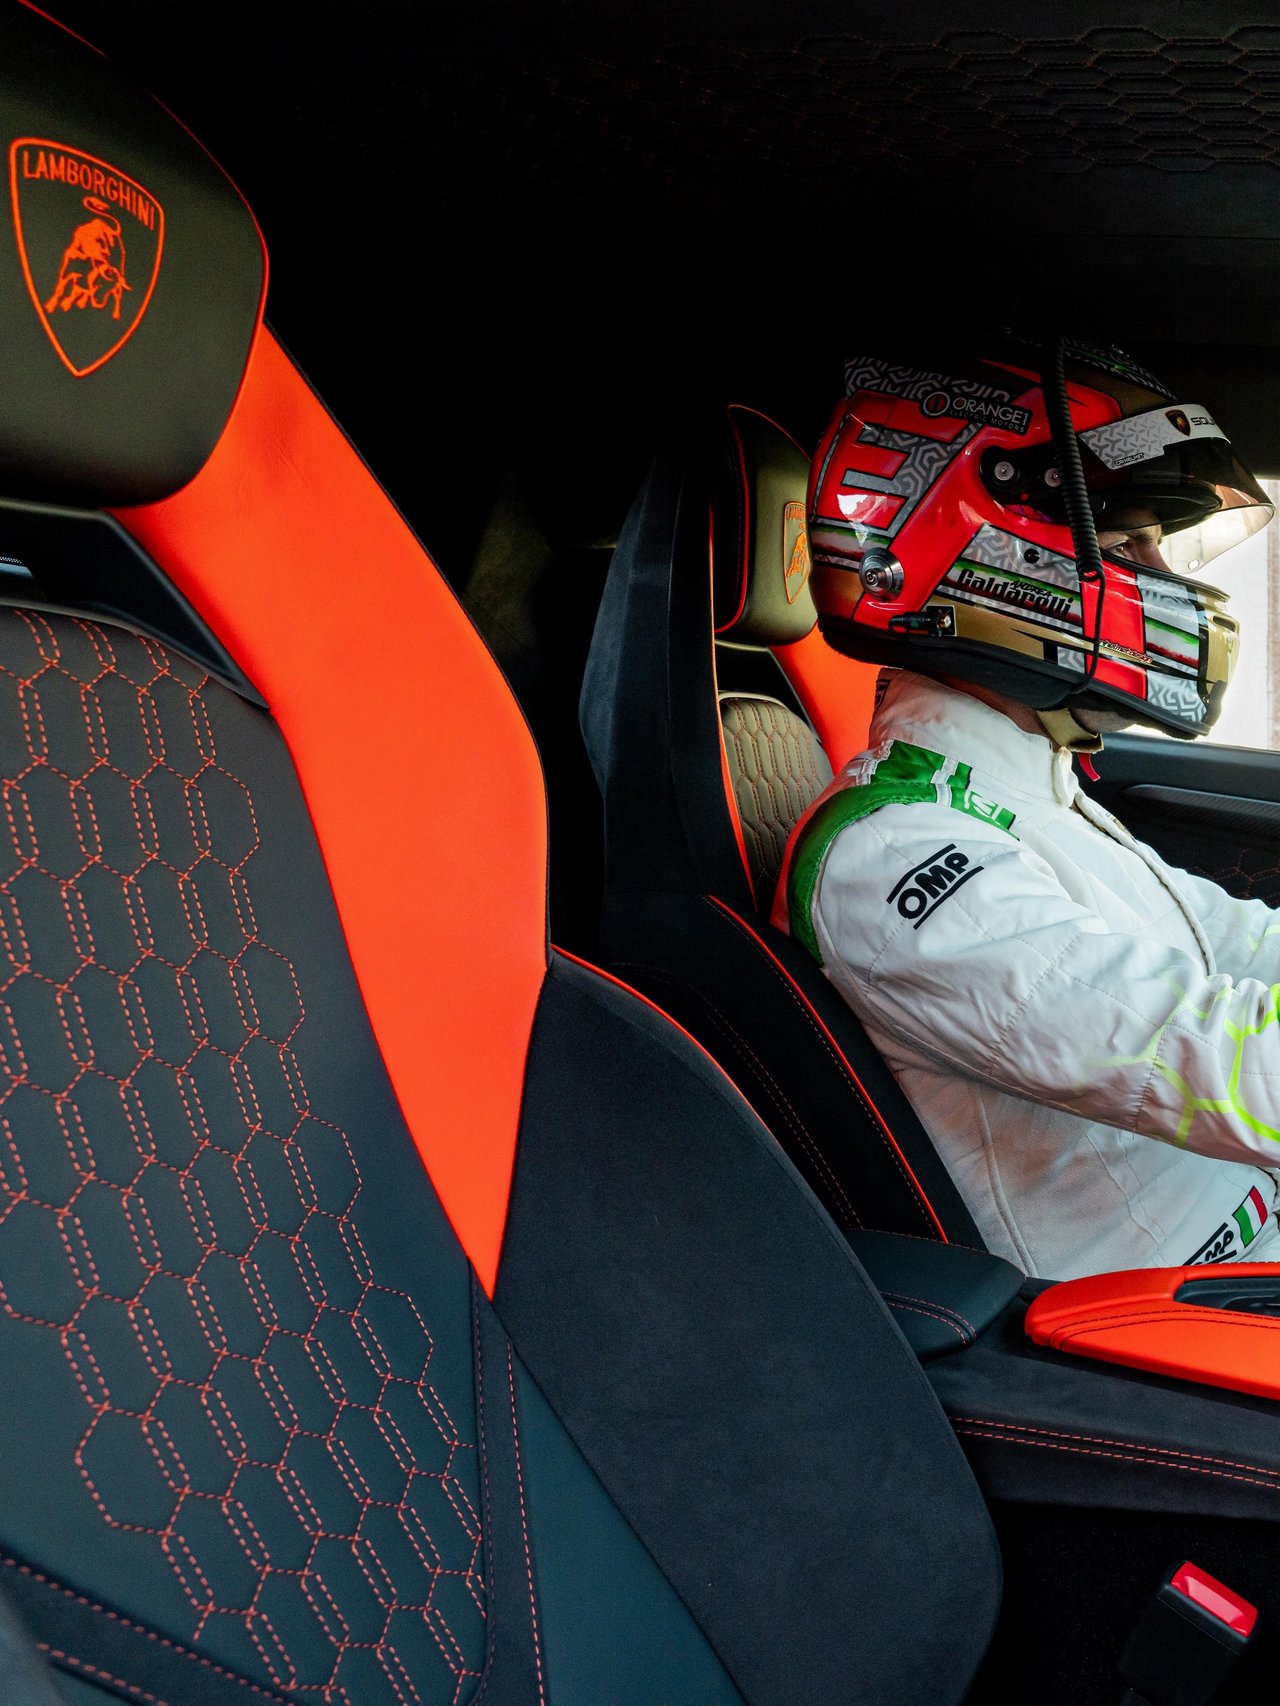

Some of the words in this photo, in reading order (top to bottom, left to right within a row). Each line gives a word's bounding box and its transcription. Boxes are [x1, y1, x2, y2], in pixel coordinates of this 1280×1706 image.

[23, 150, 156, 232] LAMBORGHINI
[949, 409, 988, 422] ELECTRIC
[991, 418, 1025, 433] MOTORS
[952, 397, 1029, 426] ORANGE1
[957, 568, 1074, 616] Caldarelli
[897, 852, 969, 919] OMP
[1197, 1230, 1235, 1264] MP
